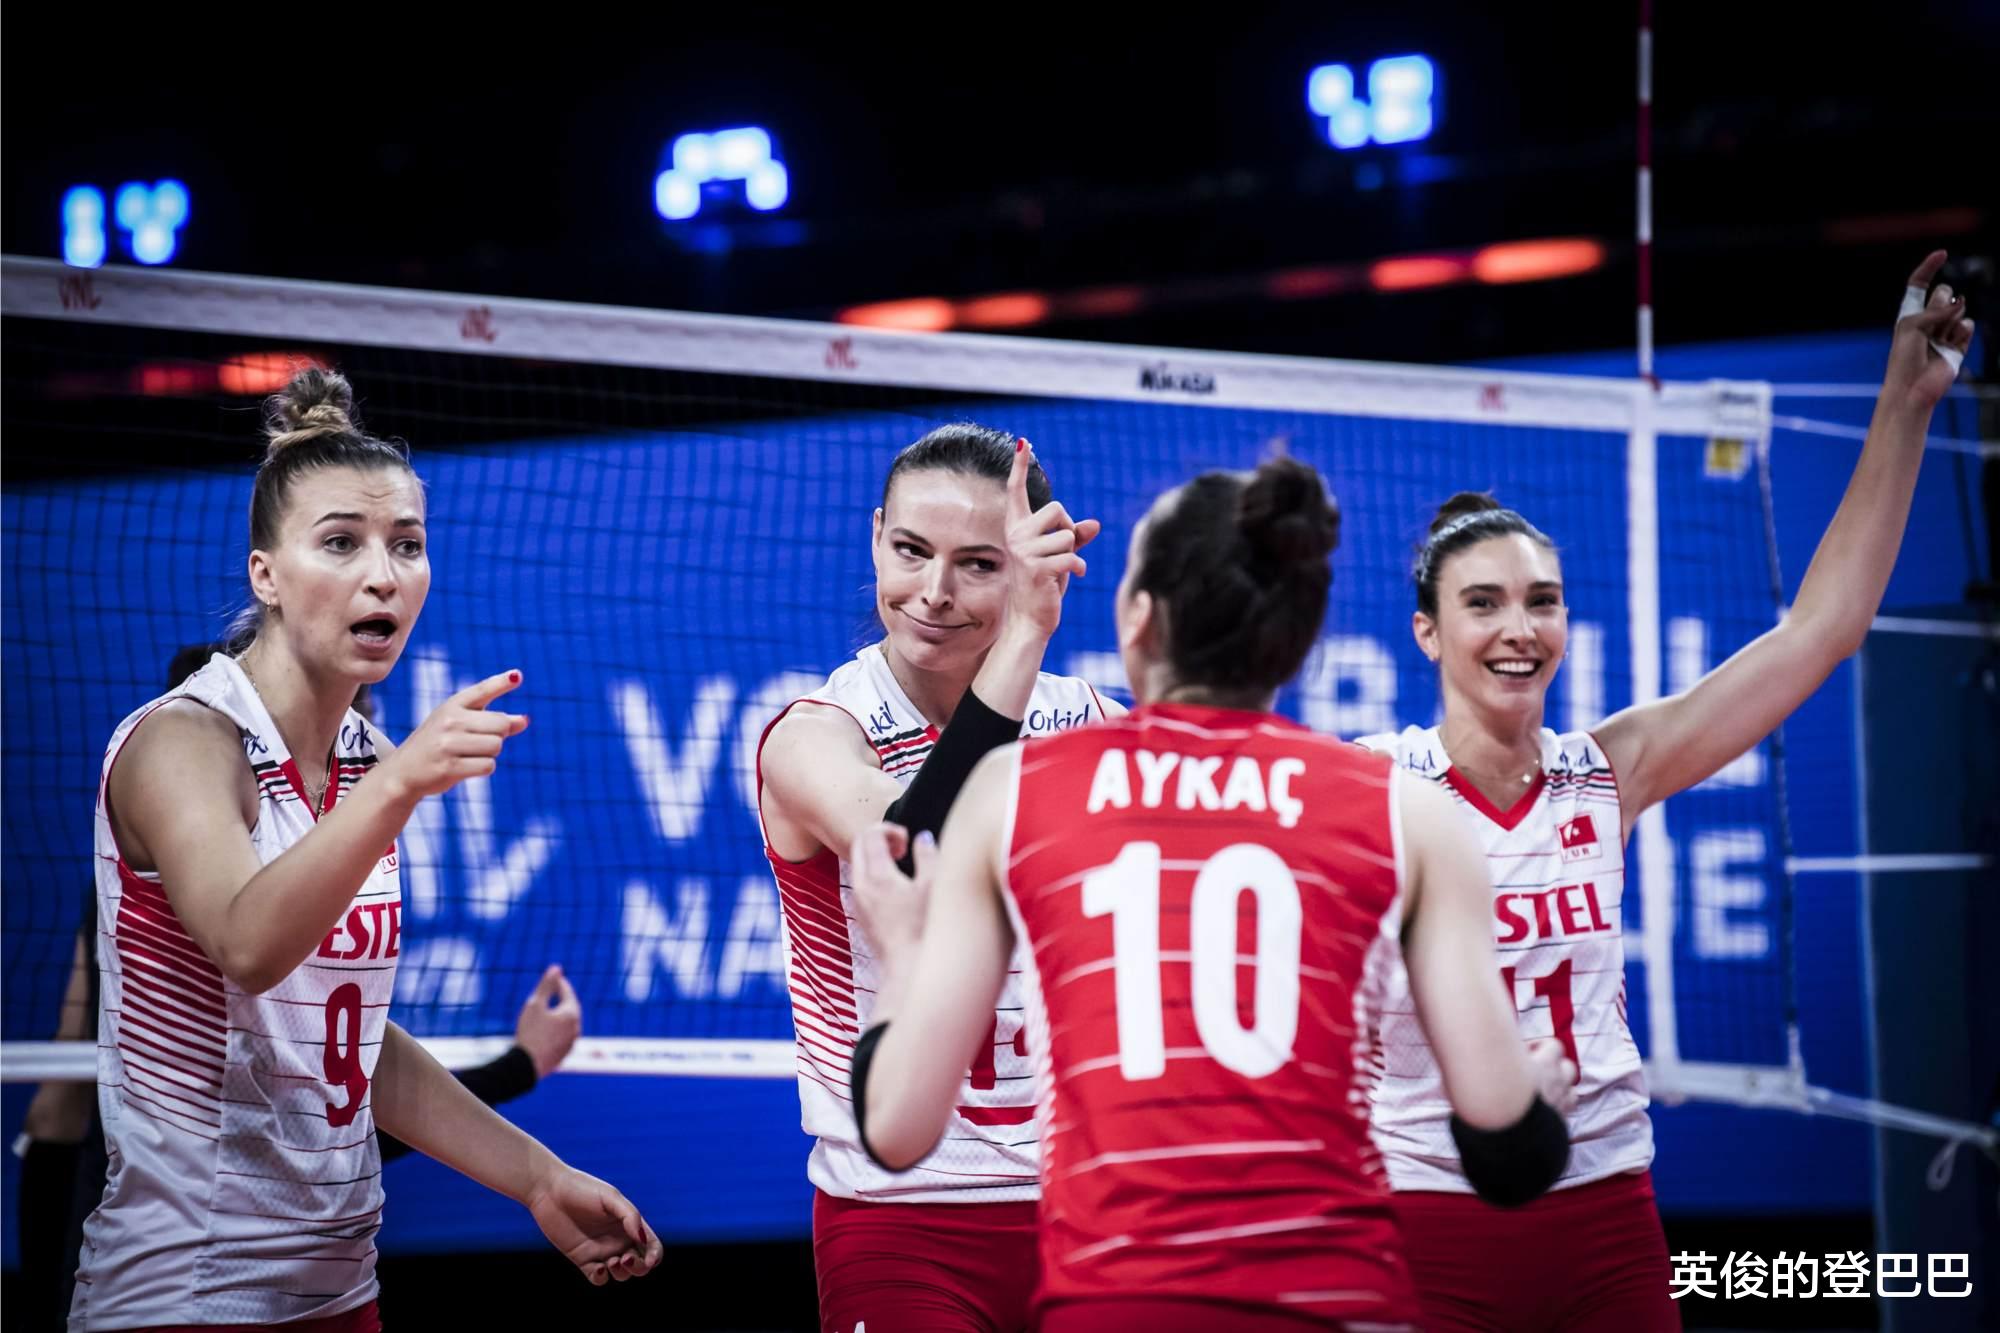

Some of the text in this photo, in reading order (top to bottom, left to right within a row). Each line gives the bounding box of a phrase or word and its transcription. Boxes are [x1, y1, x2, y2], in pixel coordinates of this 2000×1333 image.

[341, 719, 374, 751] Ork
[1029, 703, 1090, 732] Orkid
[1086, 748, 1306, 829] AYKAÇ
[317, 901, 400, 960] ESTE
[1494, 882, 1613, 943] STEL
[1081, 840, 1303, 1081] 10
[323, 982, 369, 1128] 9
